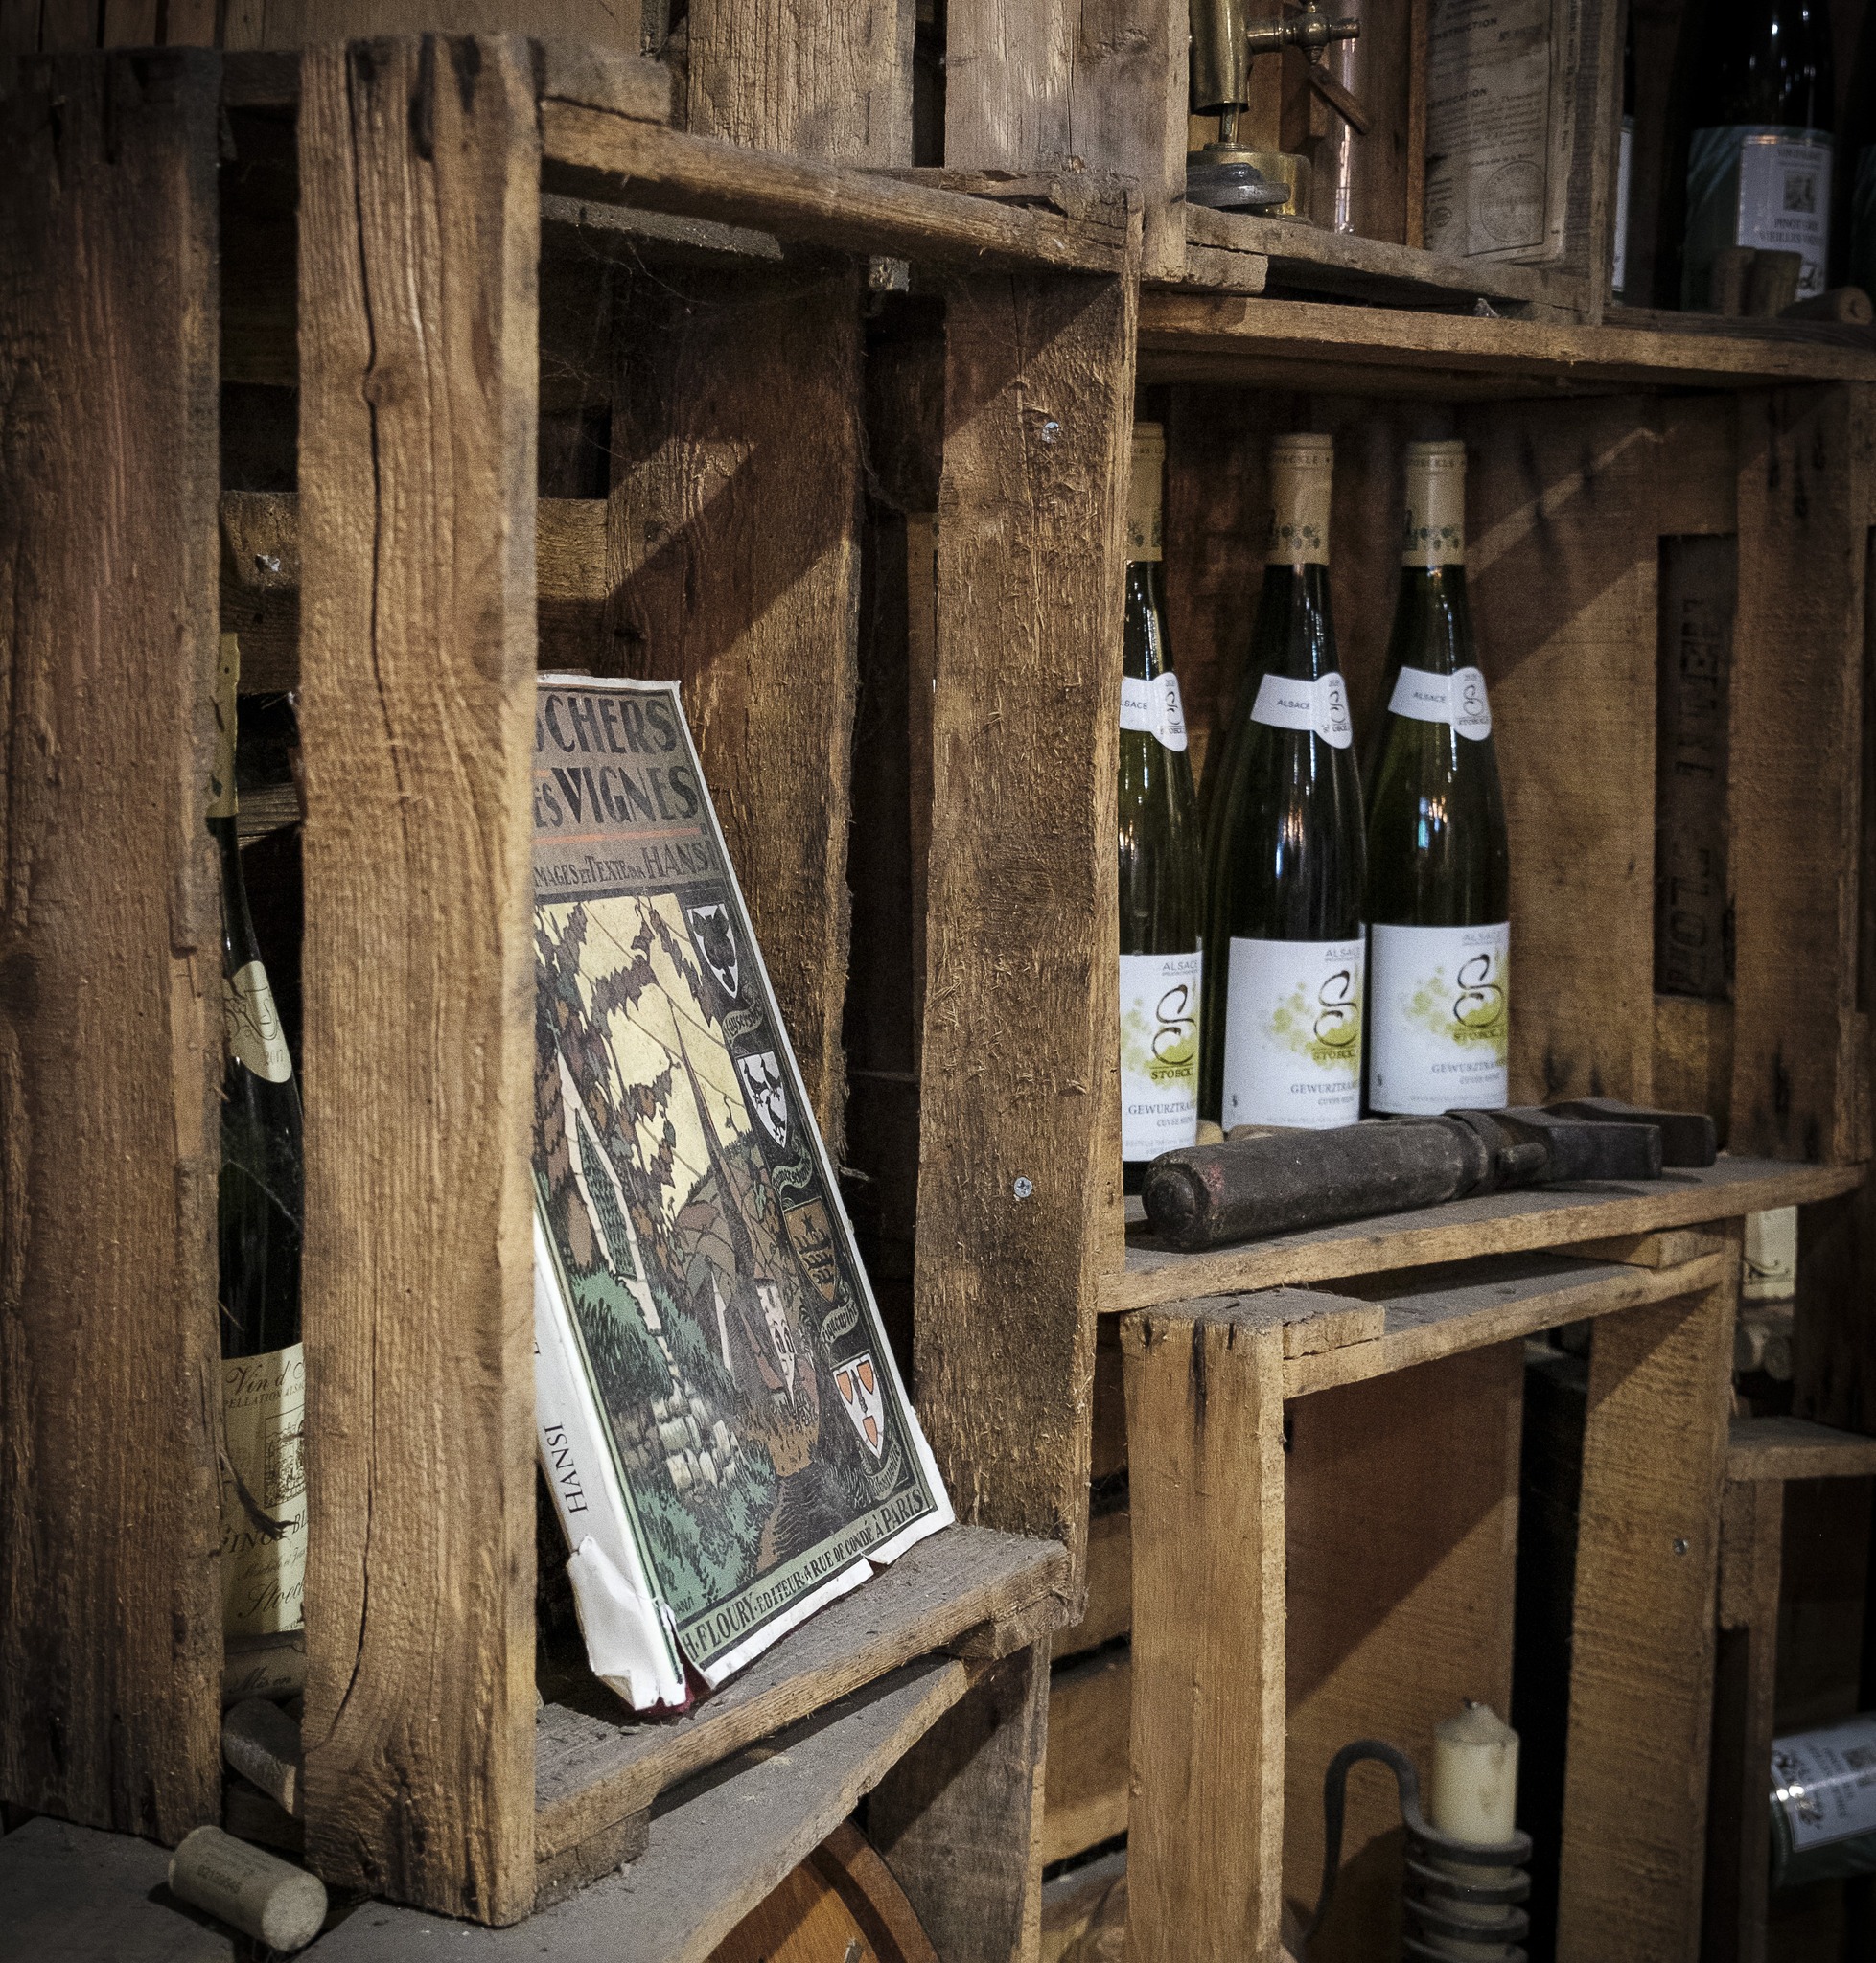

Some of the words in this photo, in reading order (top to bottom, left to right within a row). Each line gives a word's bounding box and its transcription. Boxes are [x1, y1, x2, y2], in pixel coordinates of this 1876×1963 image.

[550, 766, 699, 824] VIGNES
[584, 855, 629, 882] TEXTE
[642, 840, 721, 880] HANSI
[225, 1363, 269, 1396] Vin
[544, 1421, 589, 1513] HANSI
[811, 1551, 834, 1578] RUE
[834, 1544, 845, 1562] DE
[845, 1519, 874, 1554] CONDÉ
[881, 1488, 925, 1533] PARIS
